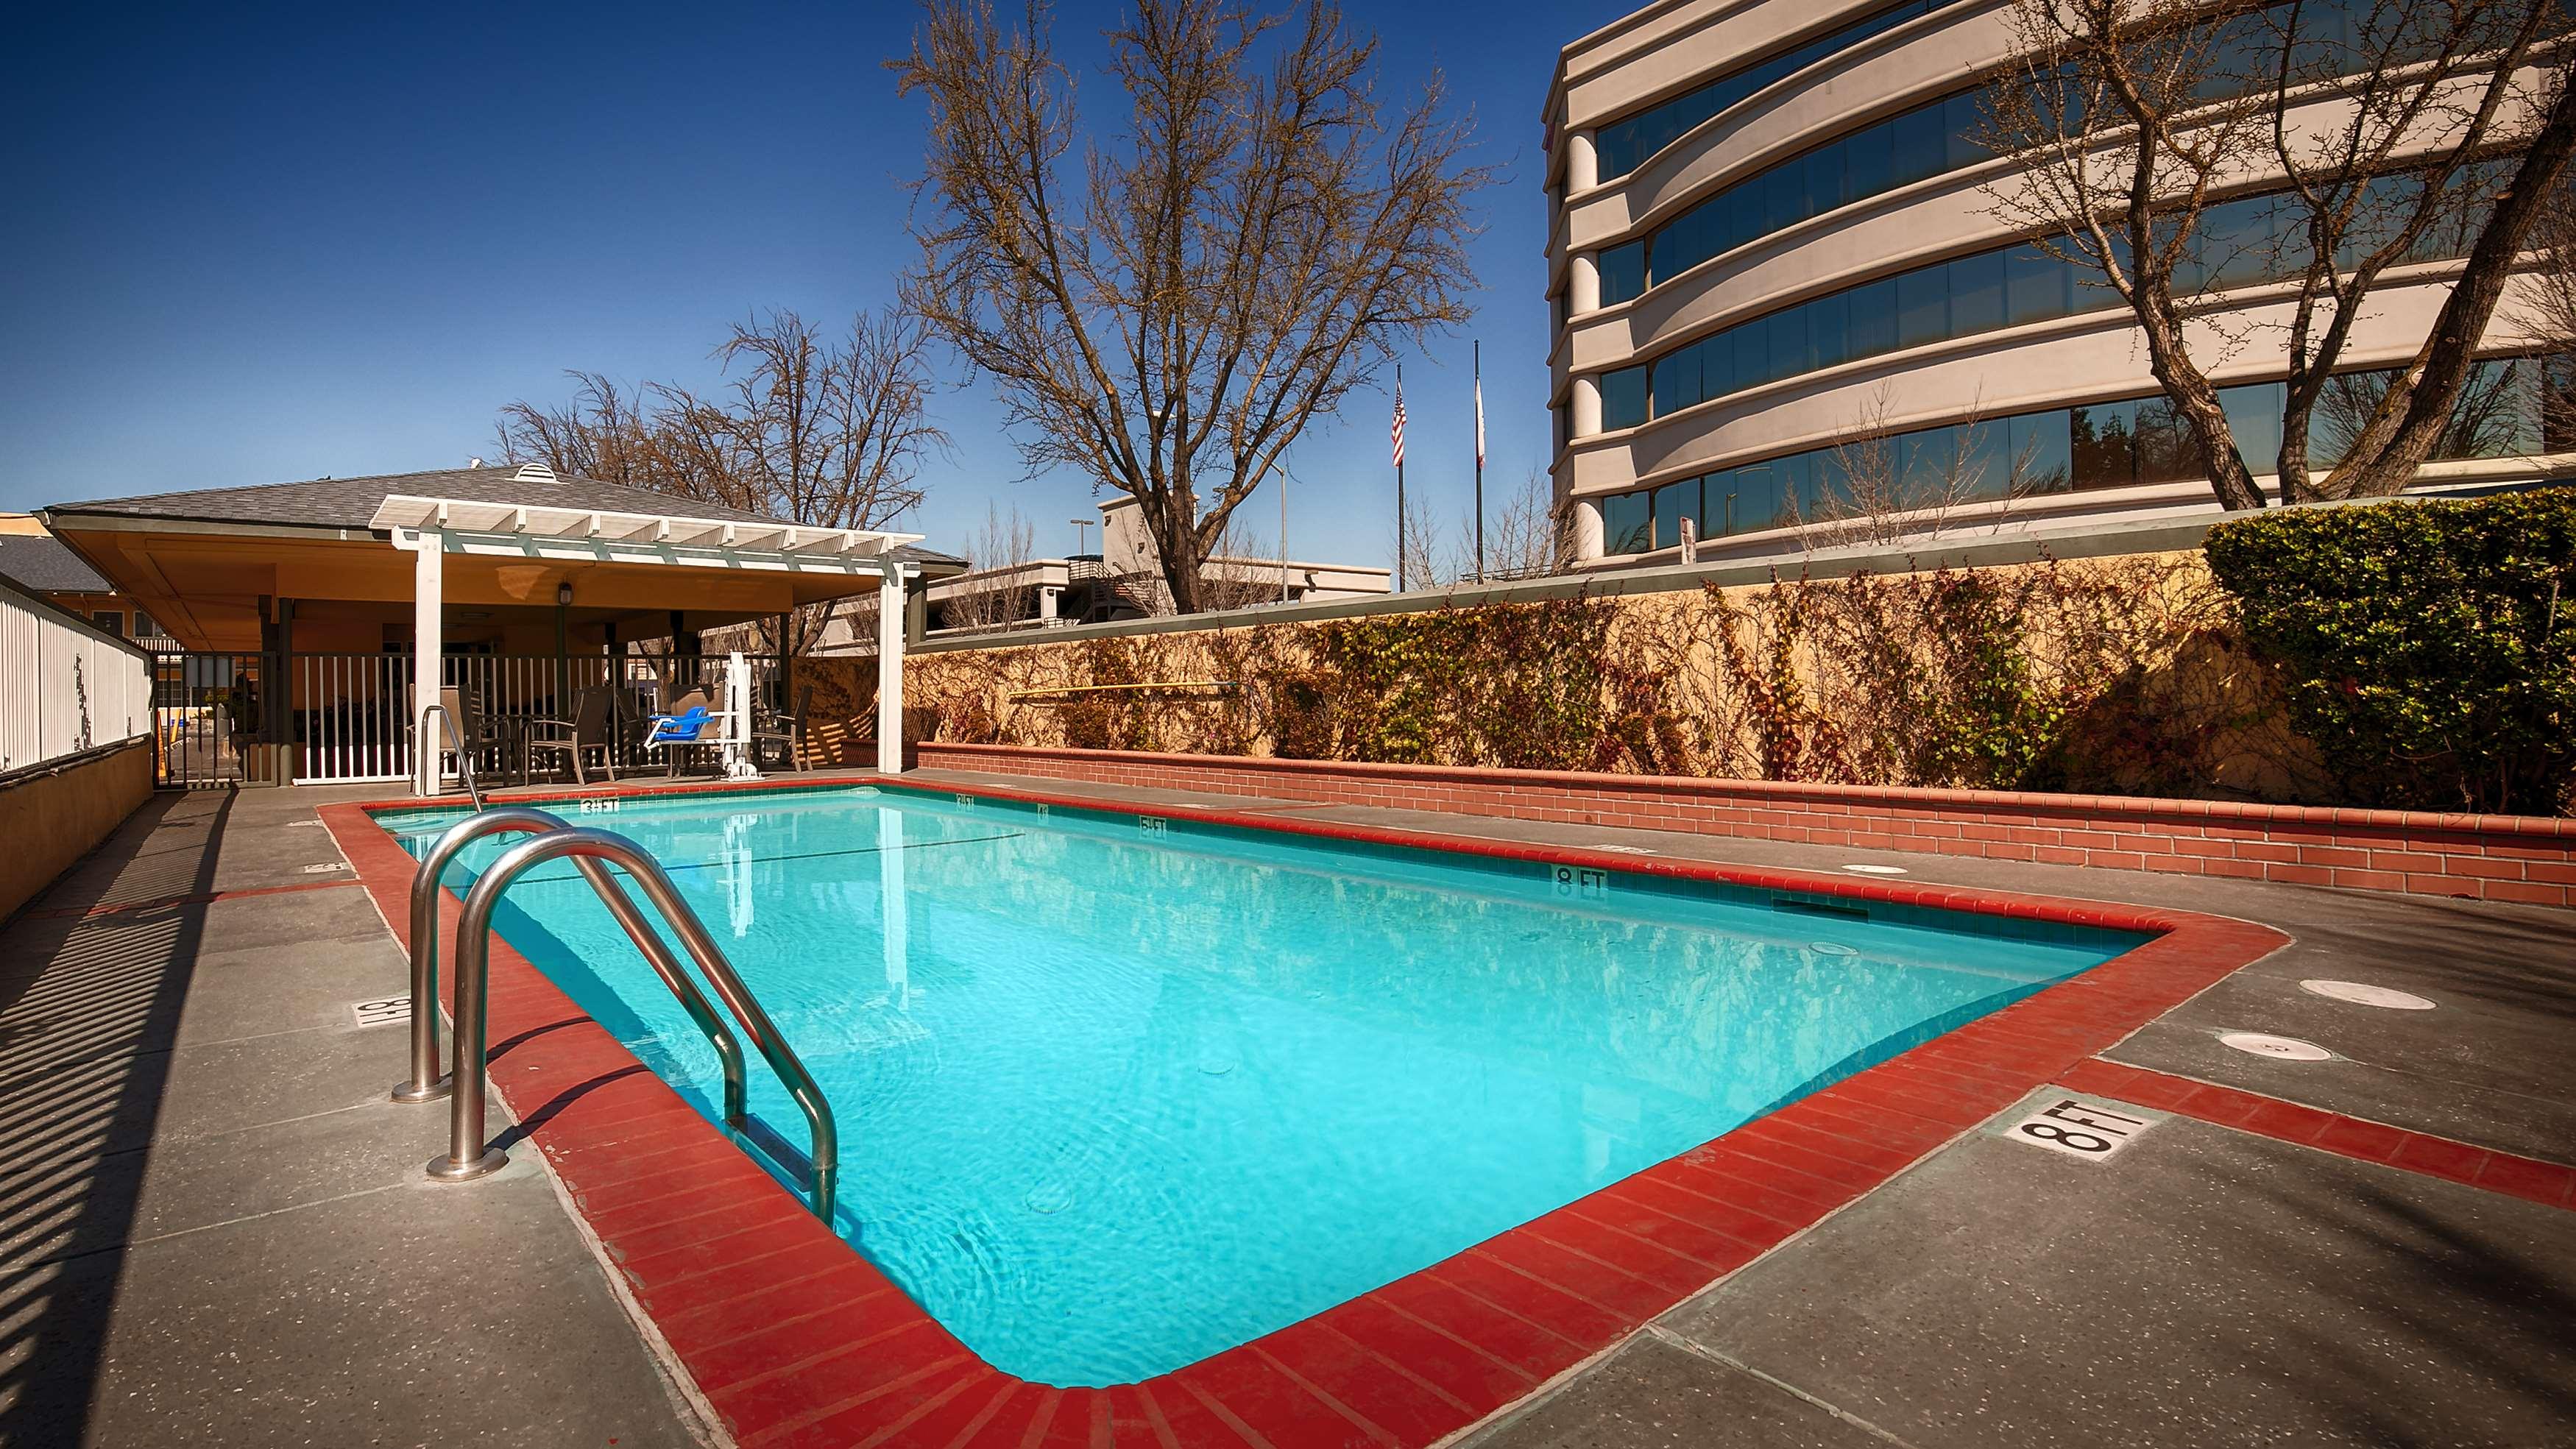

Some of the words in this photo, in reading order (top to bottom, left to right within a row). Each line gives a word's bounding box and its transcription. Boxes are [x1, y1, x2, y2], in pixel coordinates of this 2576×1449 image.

[601, 798, 618, 812] FT
[1153, 818, 1165, 831] FT
[1557, 867, 1572, 885] 8
[1579, 870, 1605, 888] FT
[358, 999, 412, 1010] 8
[2042, 1099, 2143, 1136] FT
[2021, 1123, 2112, 1152] 8
